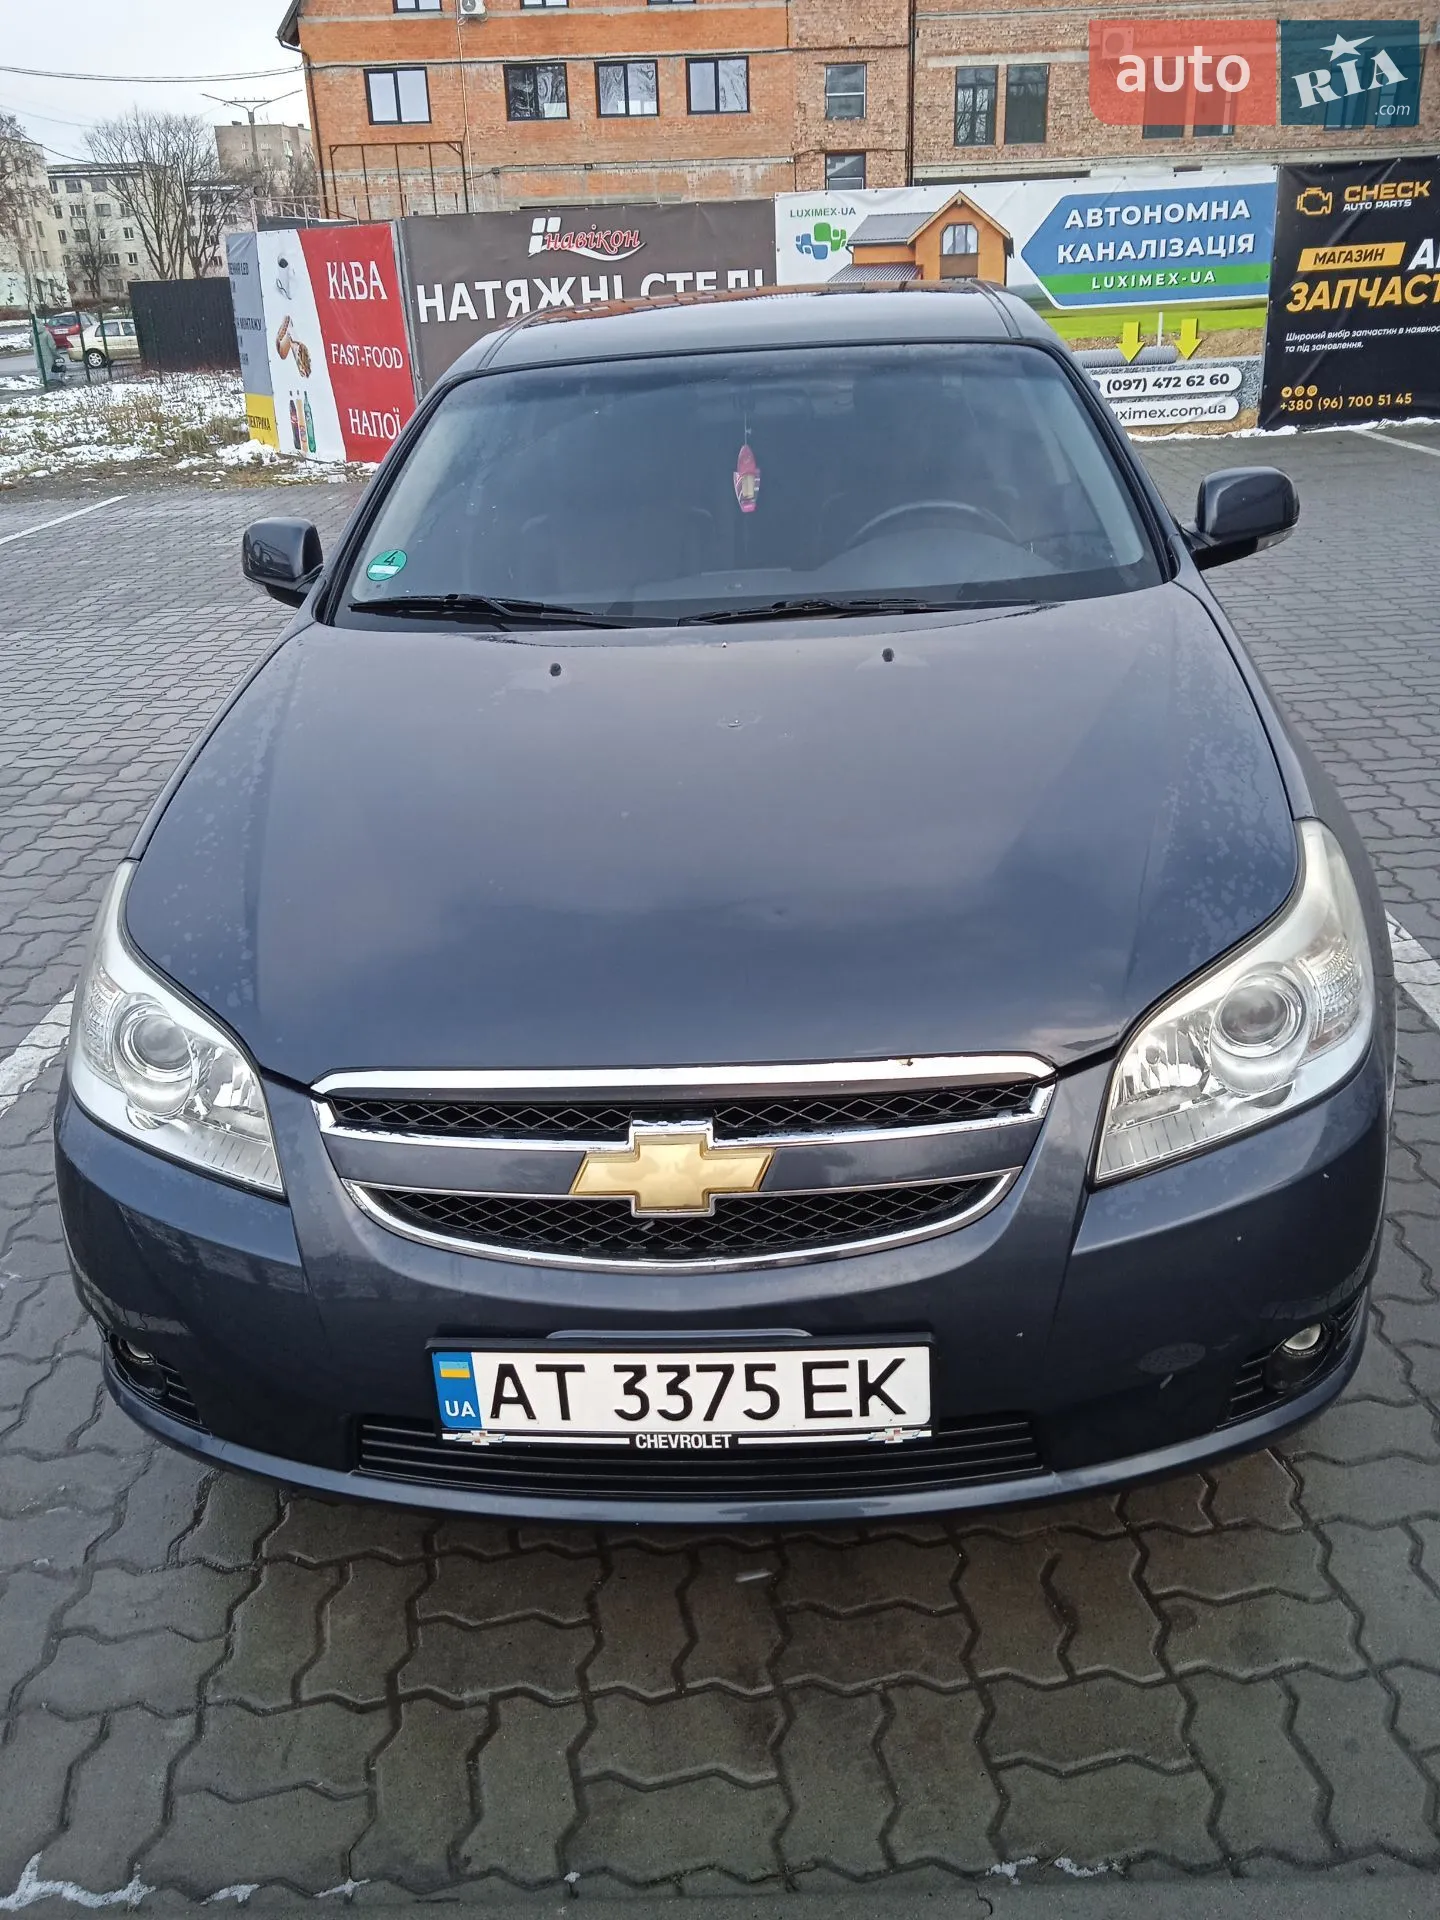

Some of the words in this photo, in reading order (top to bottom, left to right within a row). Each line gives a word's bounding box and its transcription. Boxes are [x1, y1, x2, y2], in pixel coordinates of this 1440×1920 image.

[1344, 180, 1431, 203] CHECK
[1064, 199, 1252, 230] АВТОНОМНА
[1343, 202, 1373, 212] AUTO
[1375, 199, 1412, 209] PARTS
[1057, 233, 1255, 265] КАНАЛІЗАЦІЯ
[1313, 247, 1386, 266] МАГАЗИН
[1405, 238, 1440, 272] А
[326, 261, 388, 300] КАВА
[1092, 270, 1217, 290] LUXIMEX-UA
[416, 274, 623, 323] НАТЯЖНІ
[1285, 330, 1326, 342] Широкий
[1328, 329, 1351, 340] вибір
[1352, 327, 1397, 339] запчастин
[1398, 327, 1404, 335] в
[331, 343, 403, 369] FAST-FOOD
[1285, 345, 1295, 353] та
[1296, 343, 1310, 354] під
[1106, 378, 1148, 394] (097)
[1152, 377, 1182, 389] 472
[1186, 375, 1205, 387] 62
[1209, 373, 1230, 386] 60
[1280, 398, 1313, 412] +380
[1318, 396, 1343, 411] (96)
[1348, 395, 1373, 408] 700
[1377, 394, 1391, 406] 51
[1395, 392, 1412, 405] 45
[349, 407, 401, 440] НАПОЇ
[489, 1363, 586, 1422] AT
[612, 1363, 780, 1422] 3375
[801, 1357, 907, 1419] EK
[445, 1400, 476, 1418] UA
[635, 1433, 732, 1449] CHEVROLET
